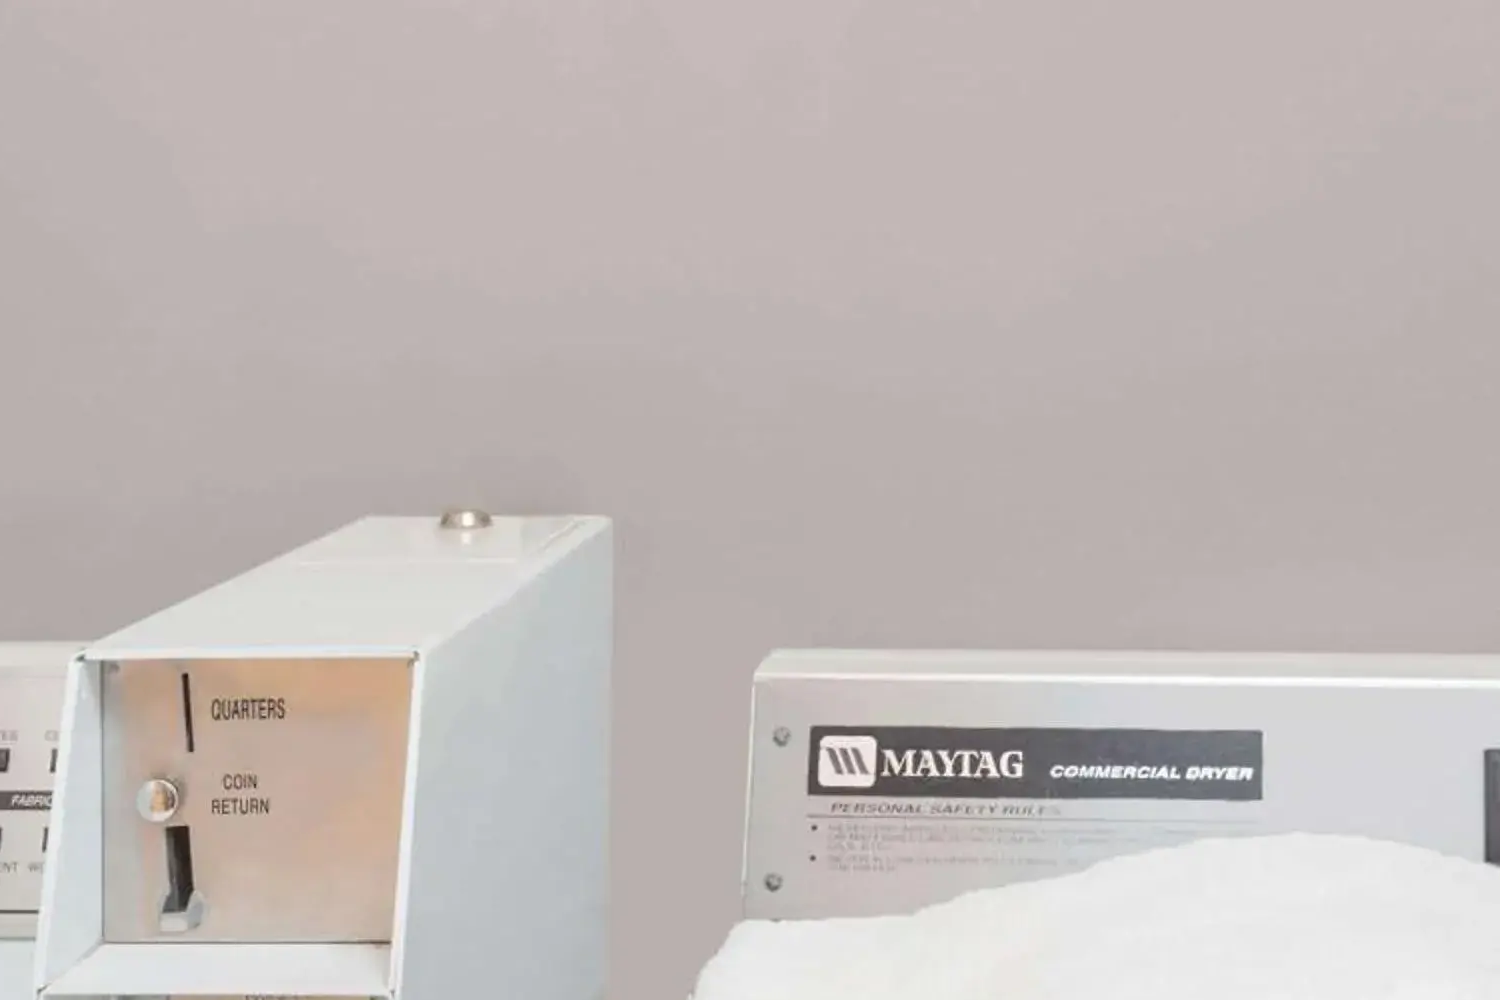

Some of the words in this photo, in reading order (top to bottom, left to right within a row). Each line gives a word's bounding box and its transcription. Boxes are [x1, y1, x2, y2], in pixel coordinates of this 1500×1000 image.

[211, 698, 285, 720] QUARTERS
[880, 749, 1023, 778] MAYTAG
[1050, 765, 1181, 780] COMMERCIAL
[1186, 766, 1254, 781] DRYER
[223, 774, 257, 789] COIN
[211, 799, 270, 814] RETURN
[831, 802, 922, 814] PERSONAL
[930, 802, 997, 815] SAFETY
